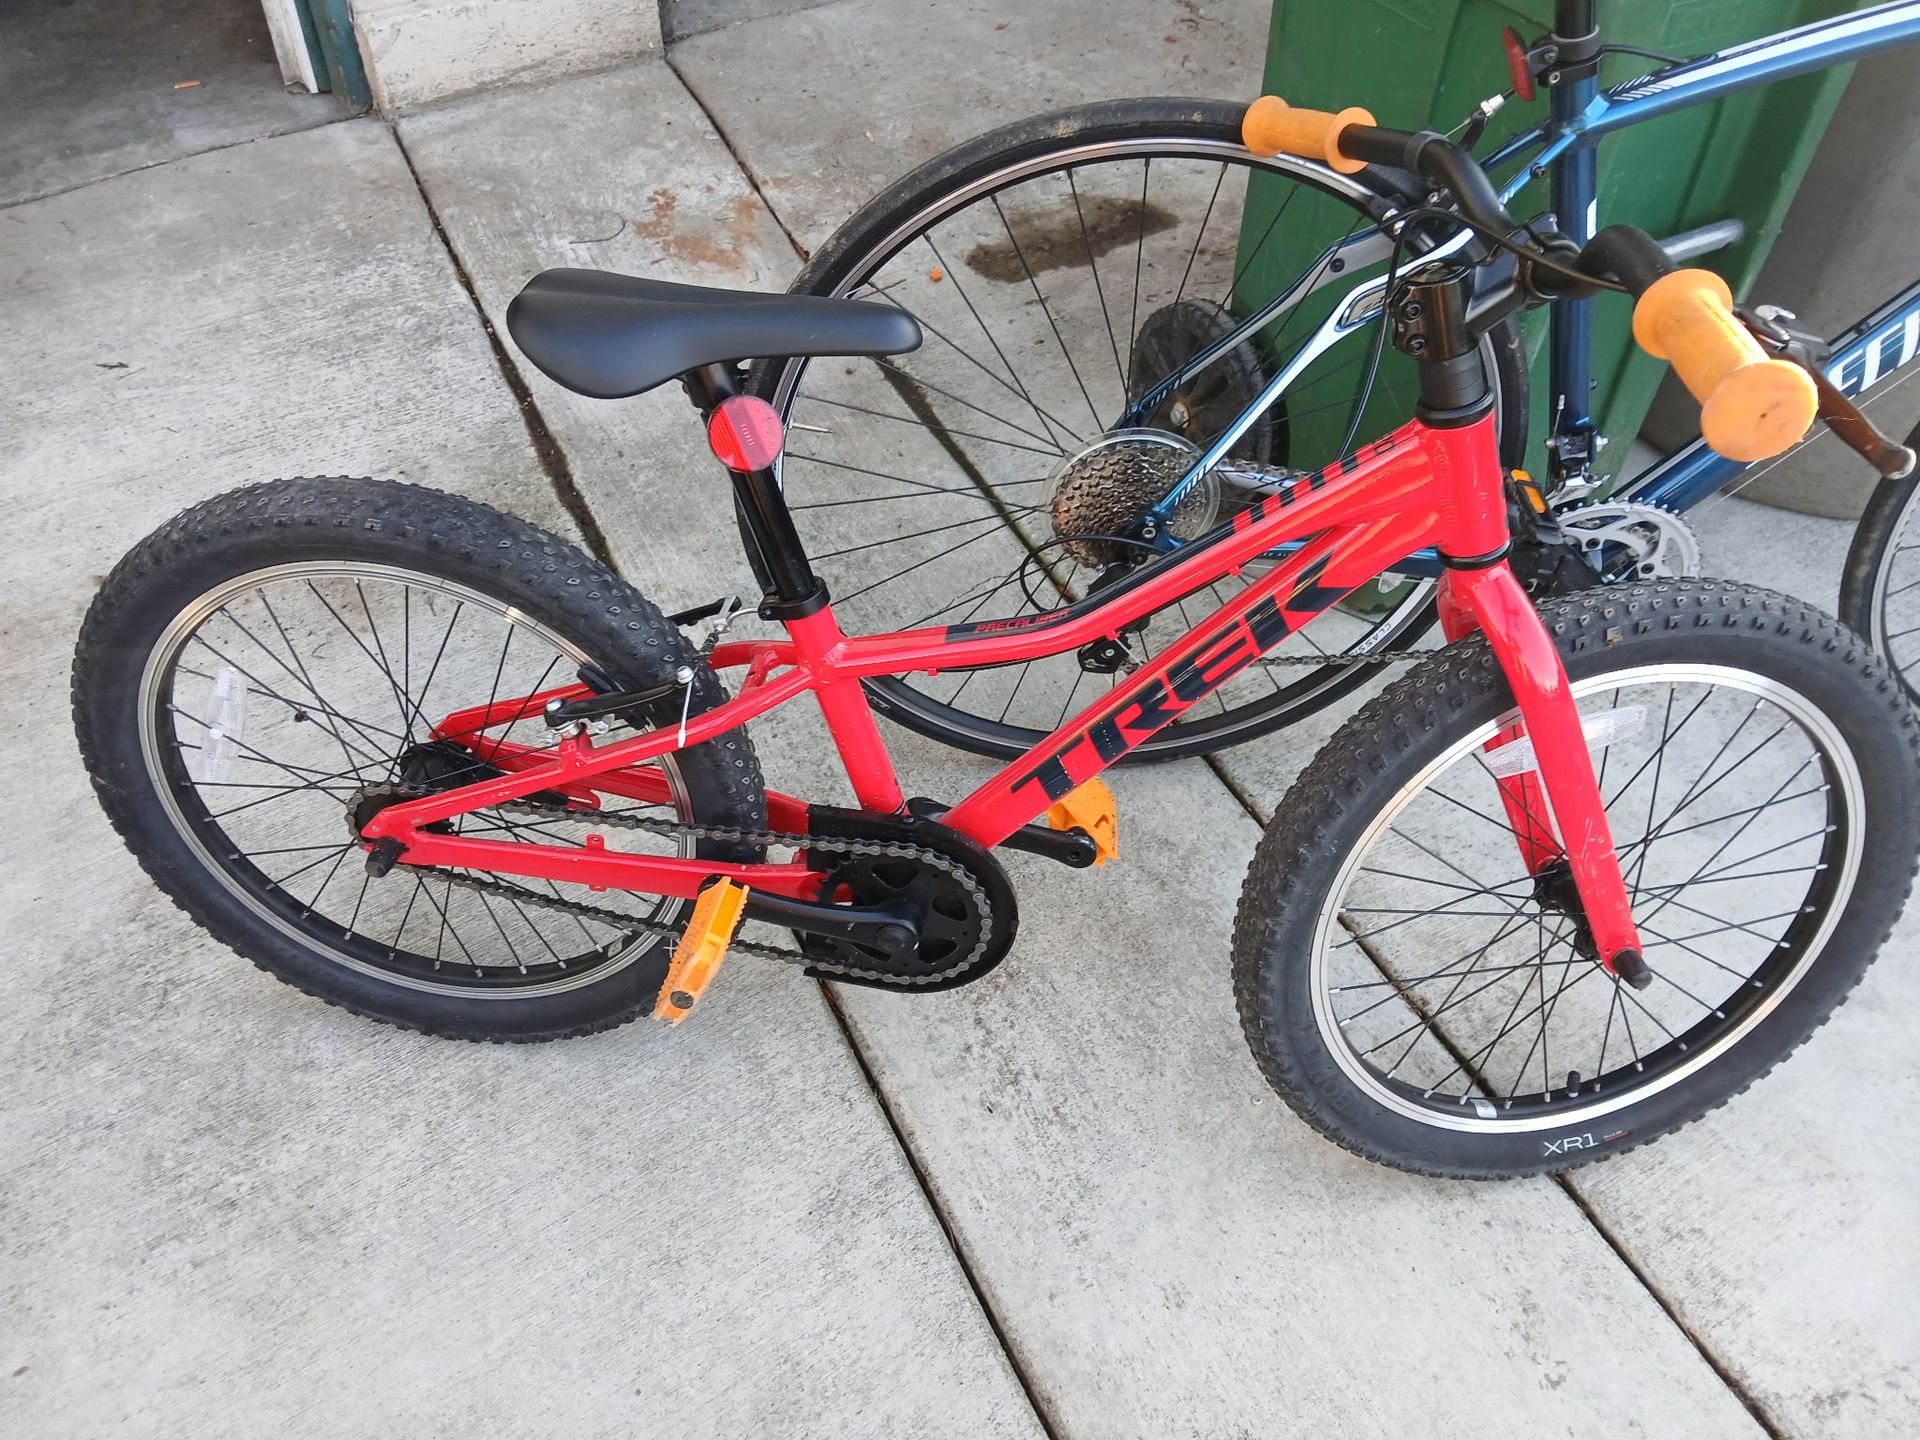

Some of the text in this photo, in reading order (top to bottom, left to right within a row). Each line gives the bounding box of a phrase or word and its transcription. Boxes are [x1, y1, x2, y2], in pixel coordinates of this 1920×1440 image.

[975, 608, 1071, 634] PRECALIBER
[1010, 550, 1358, 802] TREK
[1543, 1132, 1599, 1157] XR1
